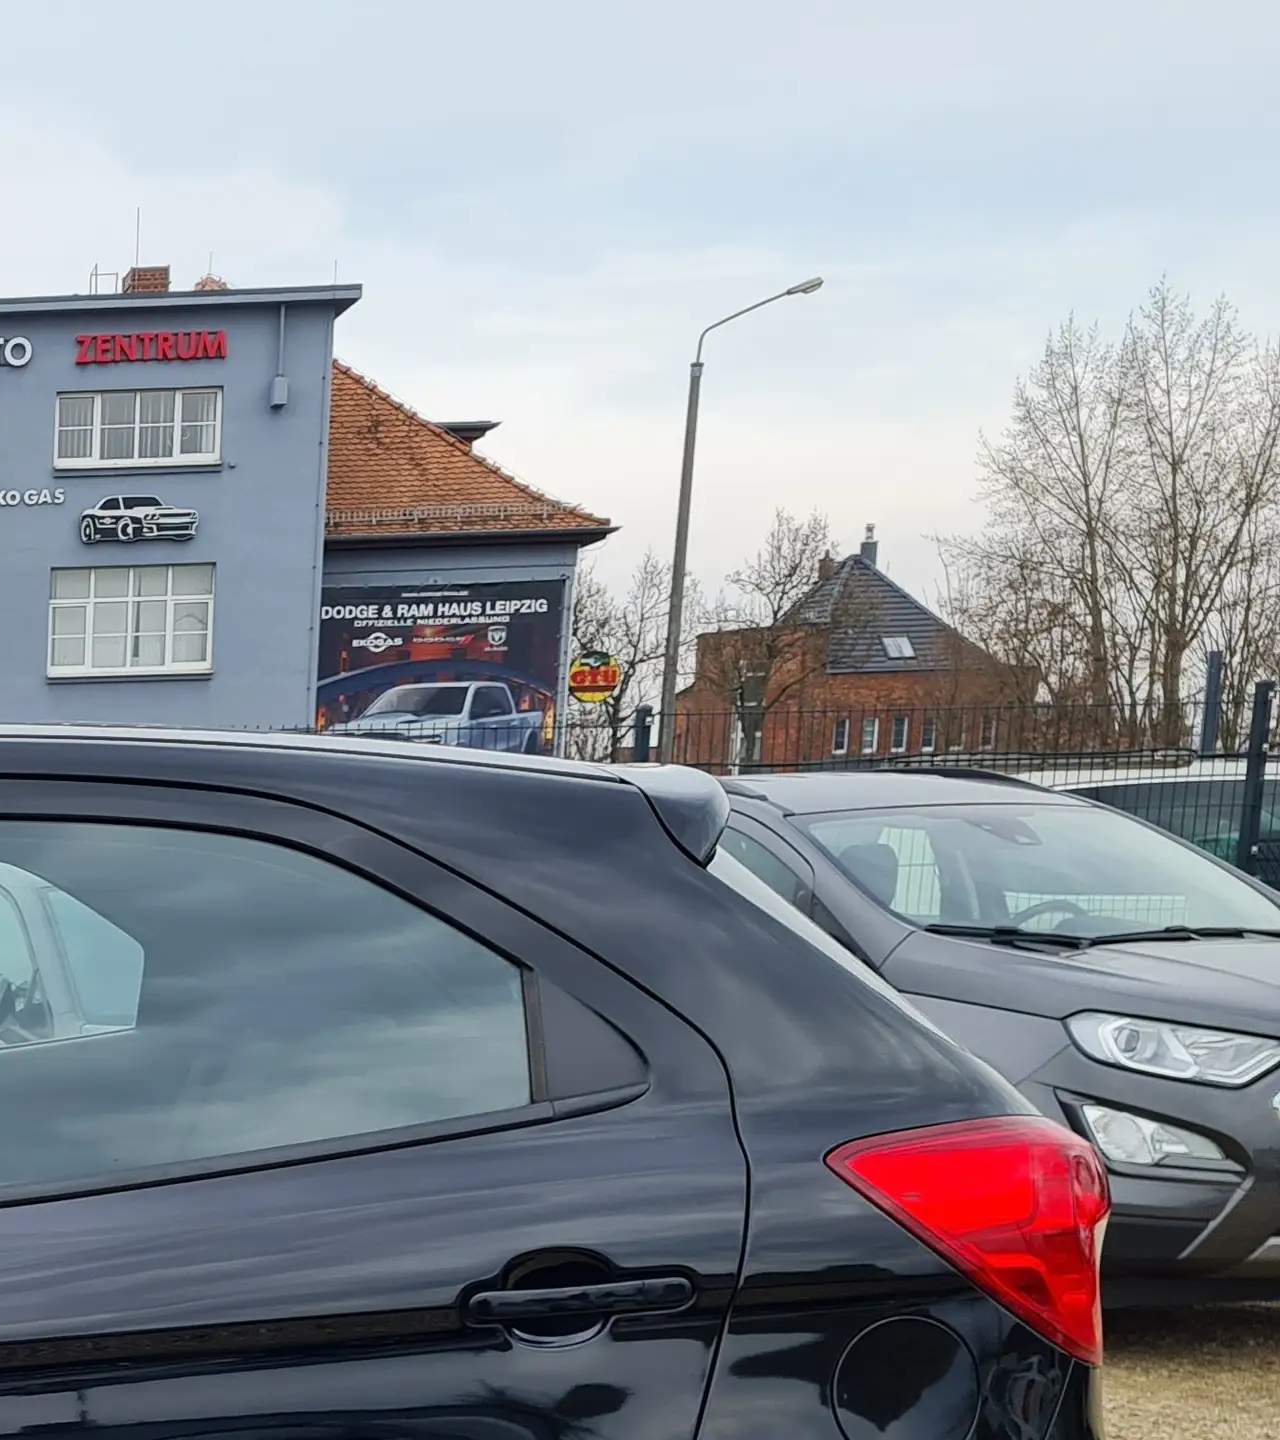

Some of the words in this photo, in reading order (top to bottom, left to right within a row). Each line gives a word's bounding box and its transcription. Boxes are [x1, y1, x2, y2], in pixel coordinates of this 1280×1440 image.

[75, 329, 228, 365] ZENTRUM
[321, 605, 379, 619] DODGE
[382, 604, 394, 618] &
[397, 603, 435, 618] RAM
[437, 601, 483, 616] HAUS
[485, 599, 548, 615] LEIPZIG
